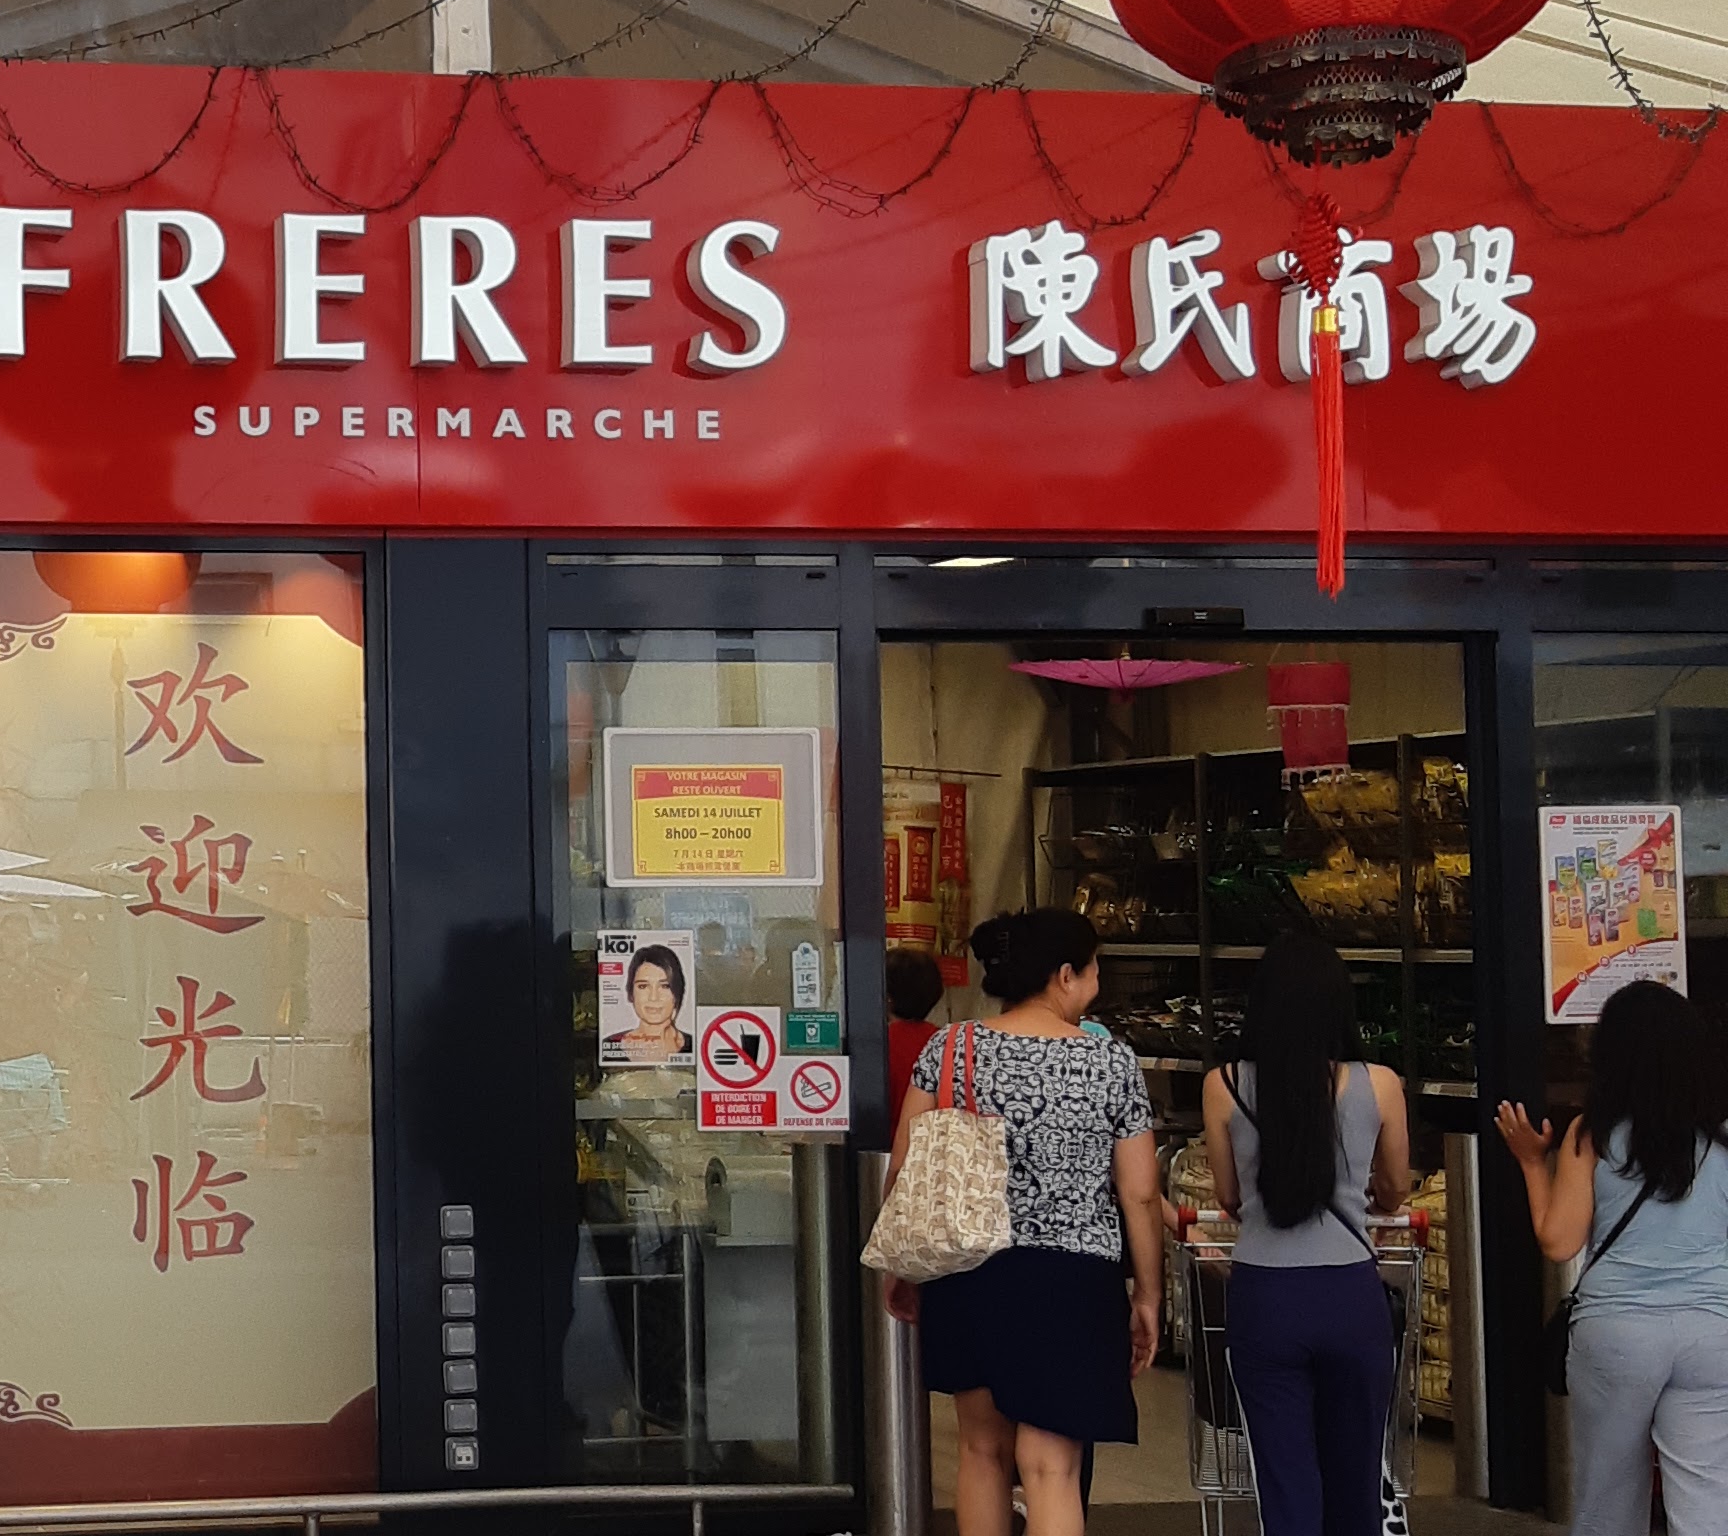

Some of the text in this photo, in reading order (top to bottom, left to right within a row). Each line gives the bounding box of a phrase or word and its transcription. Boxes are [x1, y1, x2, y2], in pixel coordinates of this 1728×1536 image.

[968, 219, 1537, 386] 陳氏商場
[193, 405, 721, 441] SUPERMARCHE
[666, 771, 747, 781] VOTRE MAGASIN
[672, 785, 742, 795] RESTE OUVERT
[654, 807, 762, 818] SAMEDI 14 JUILLET
[665, 827, 697, 840] 8h00
[711, 827, 752, 840] 20h00
[124, 641, 266, 1273] 欢迎光临
[710, 1093, 767, 1103] INTERDICTION
[715, 1104, 726, 1114] DE
[752, 1104, 762, 1114] ET
[715, 1115, 763, 1125] DE MANGER
